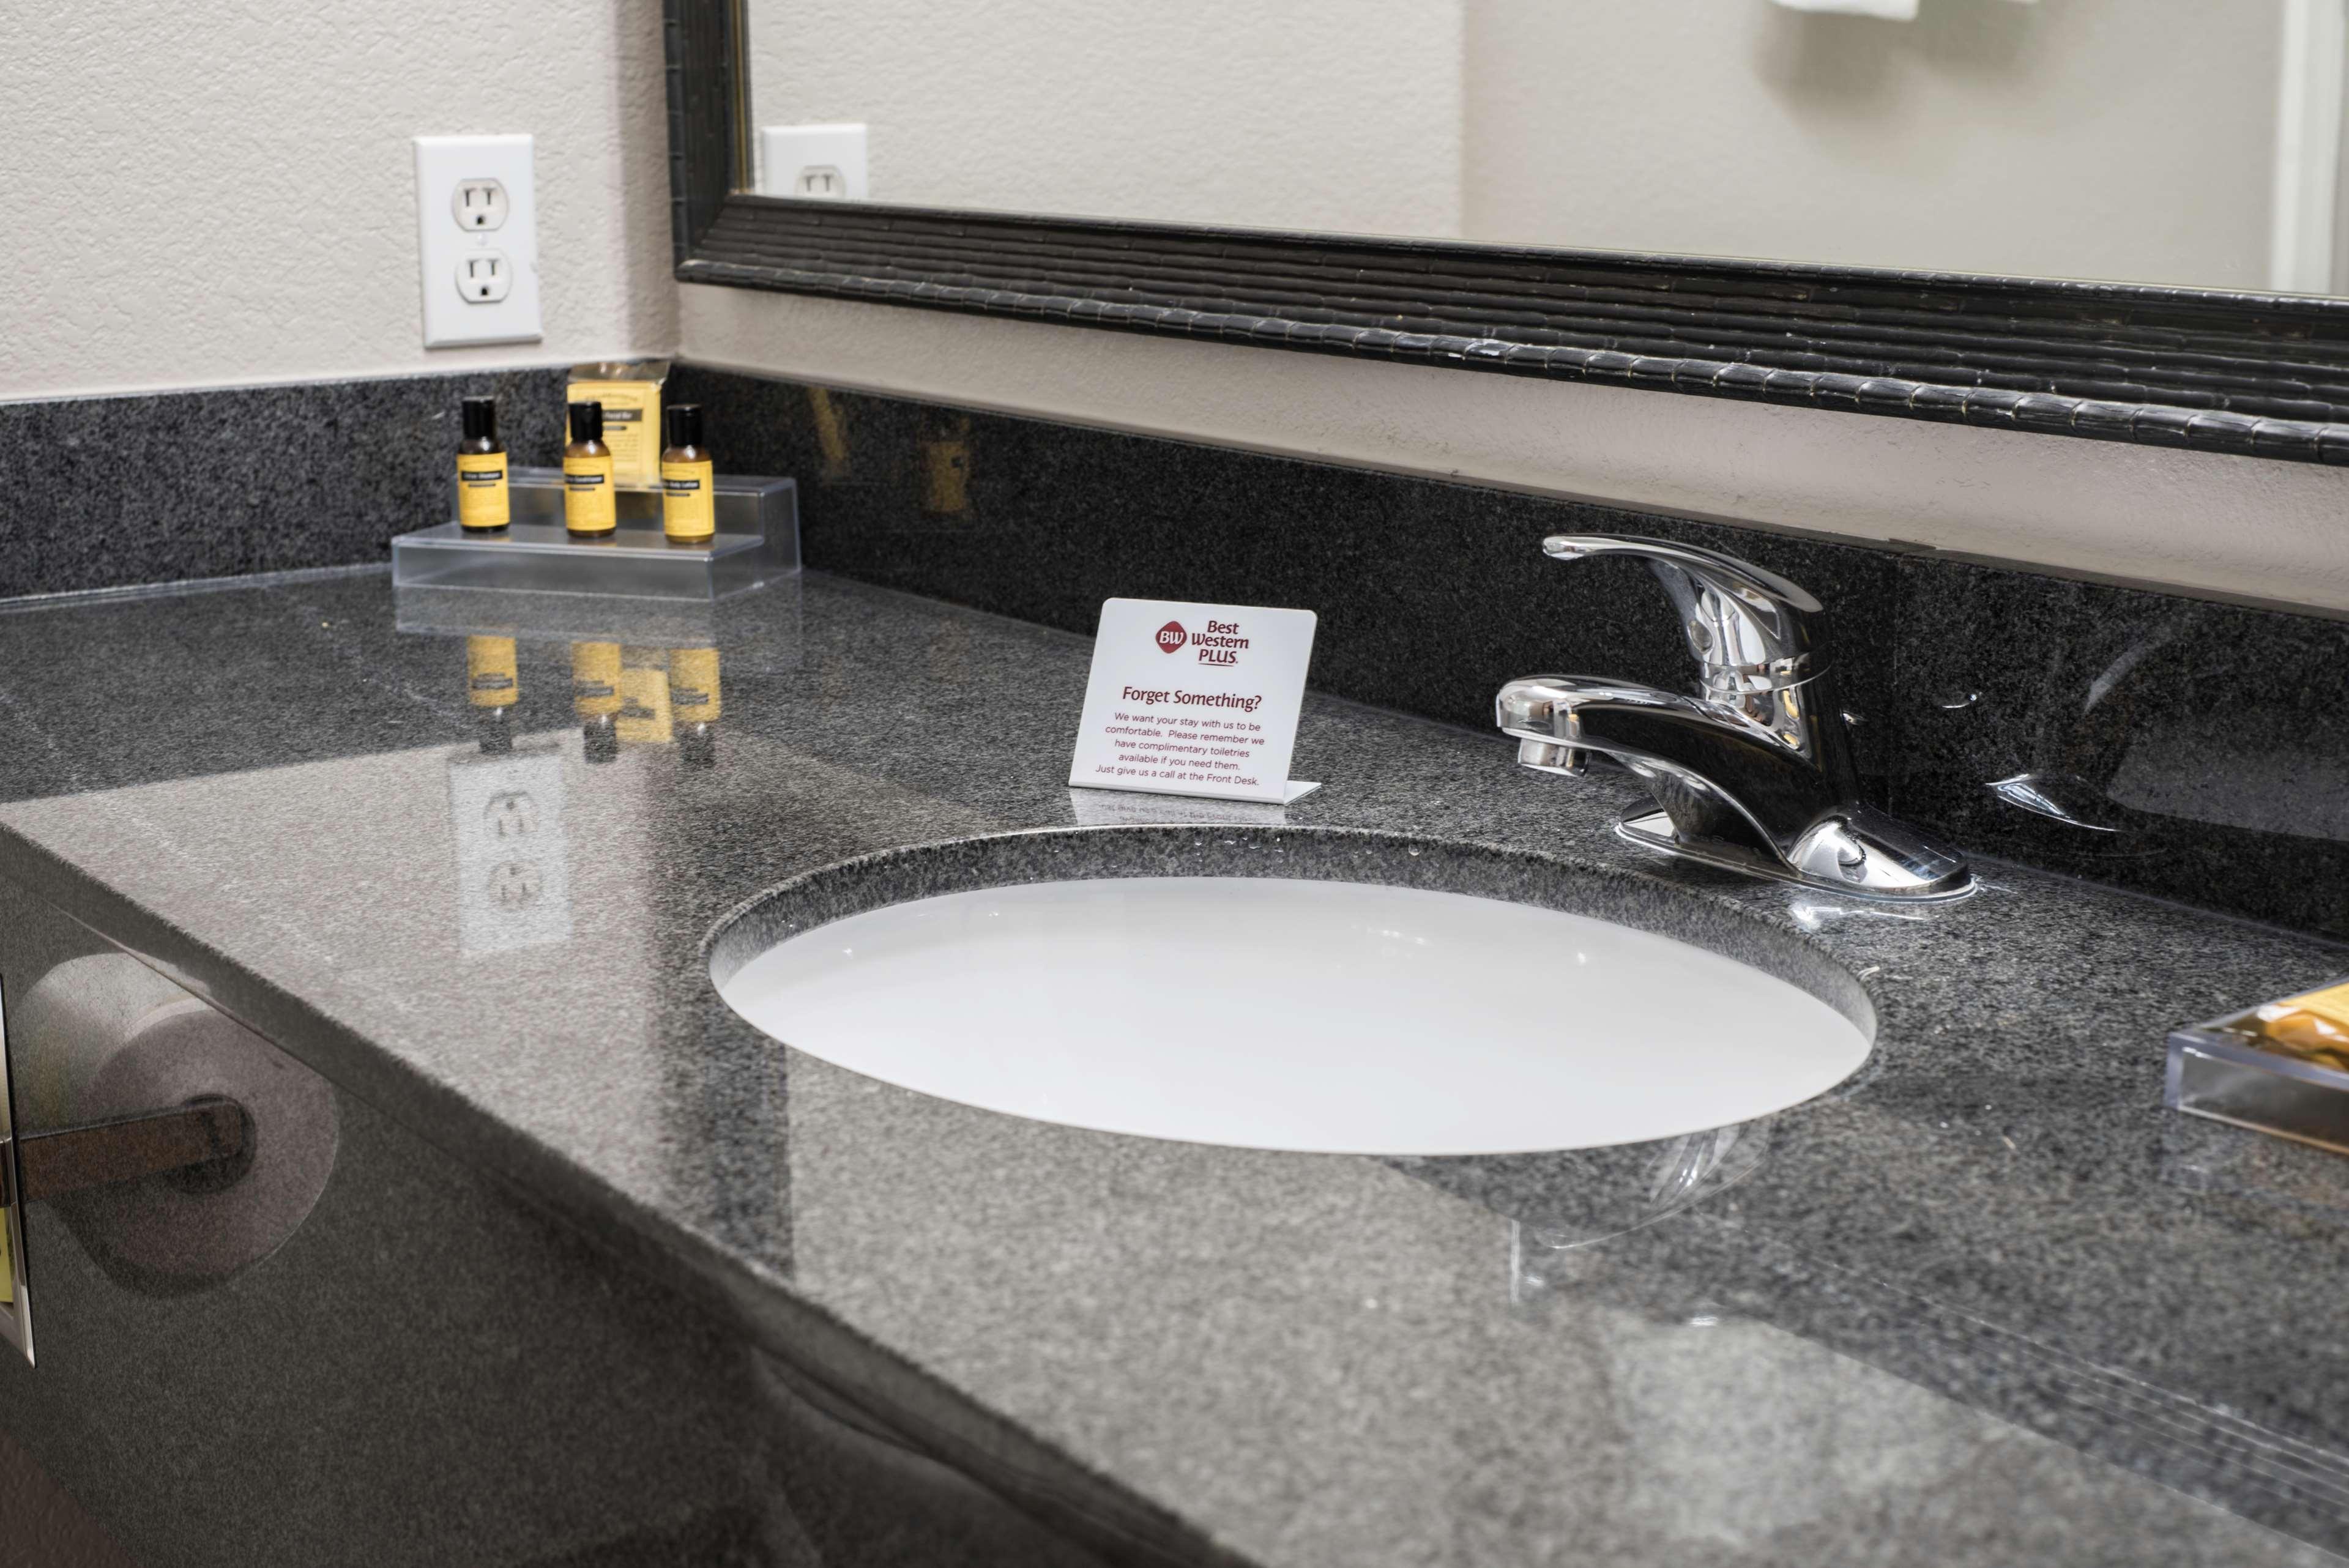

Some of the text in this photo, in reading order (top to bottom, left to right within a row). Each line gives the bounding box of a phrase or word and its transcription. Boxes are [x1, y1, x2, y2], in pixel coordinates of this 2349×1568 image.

[1207, 620, 1239, 634] Best
[1160, 631, 1183, 644] BW
[1191, 633, 1249, 649] Western
[1123, 686, 1262, 712] Forget Something?
[1180, 718, 1199, 727] stay
[1202, 719, 1221, 728] with
[1106, 726, 1163, 737] comfortable.
[1168, 730, 1197, 740] Please
[1200, 734, 1248, 743] remember
[1115, 739, 1249, 757] have complimentary toiletries
[1119, 754, 1158, 764] available
[1215, 761, 1240, 770] them.
[1095, 765, 1115, 773] Just
[1117, 766, 1136, 776] give
[1207, 774, 1231, 783] Front
[1235, 776, 1259, 786] Desk.
